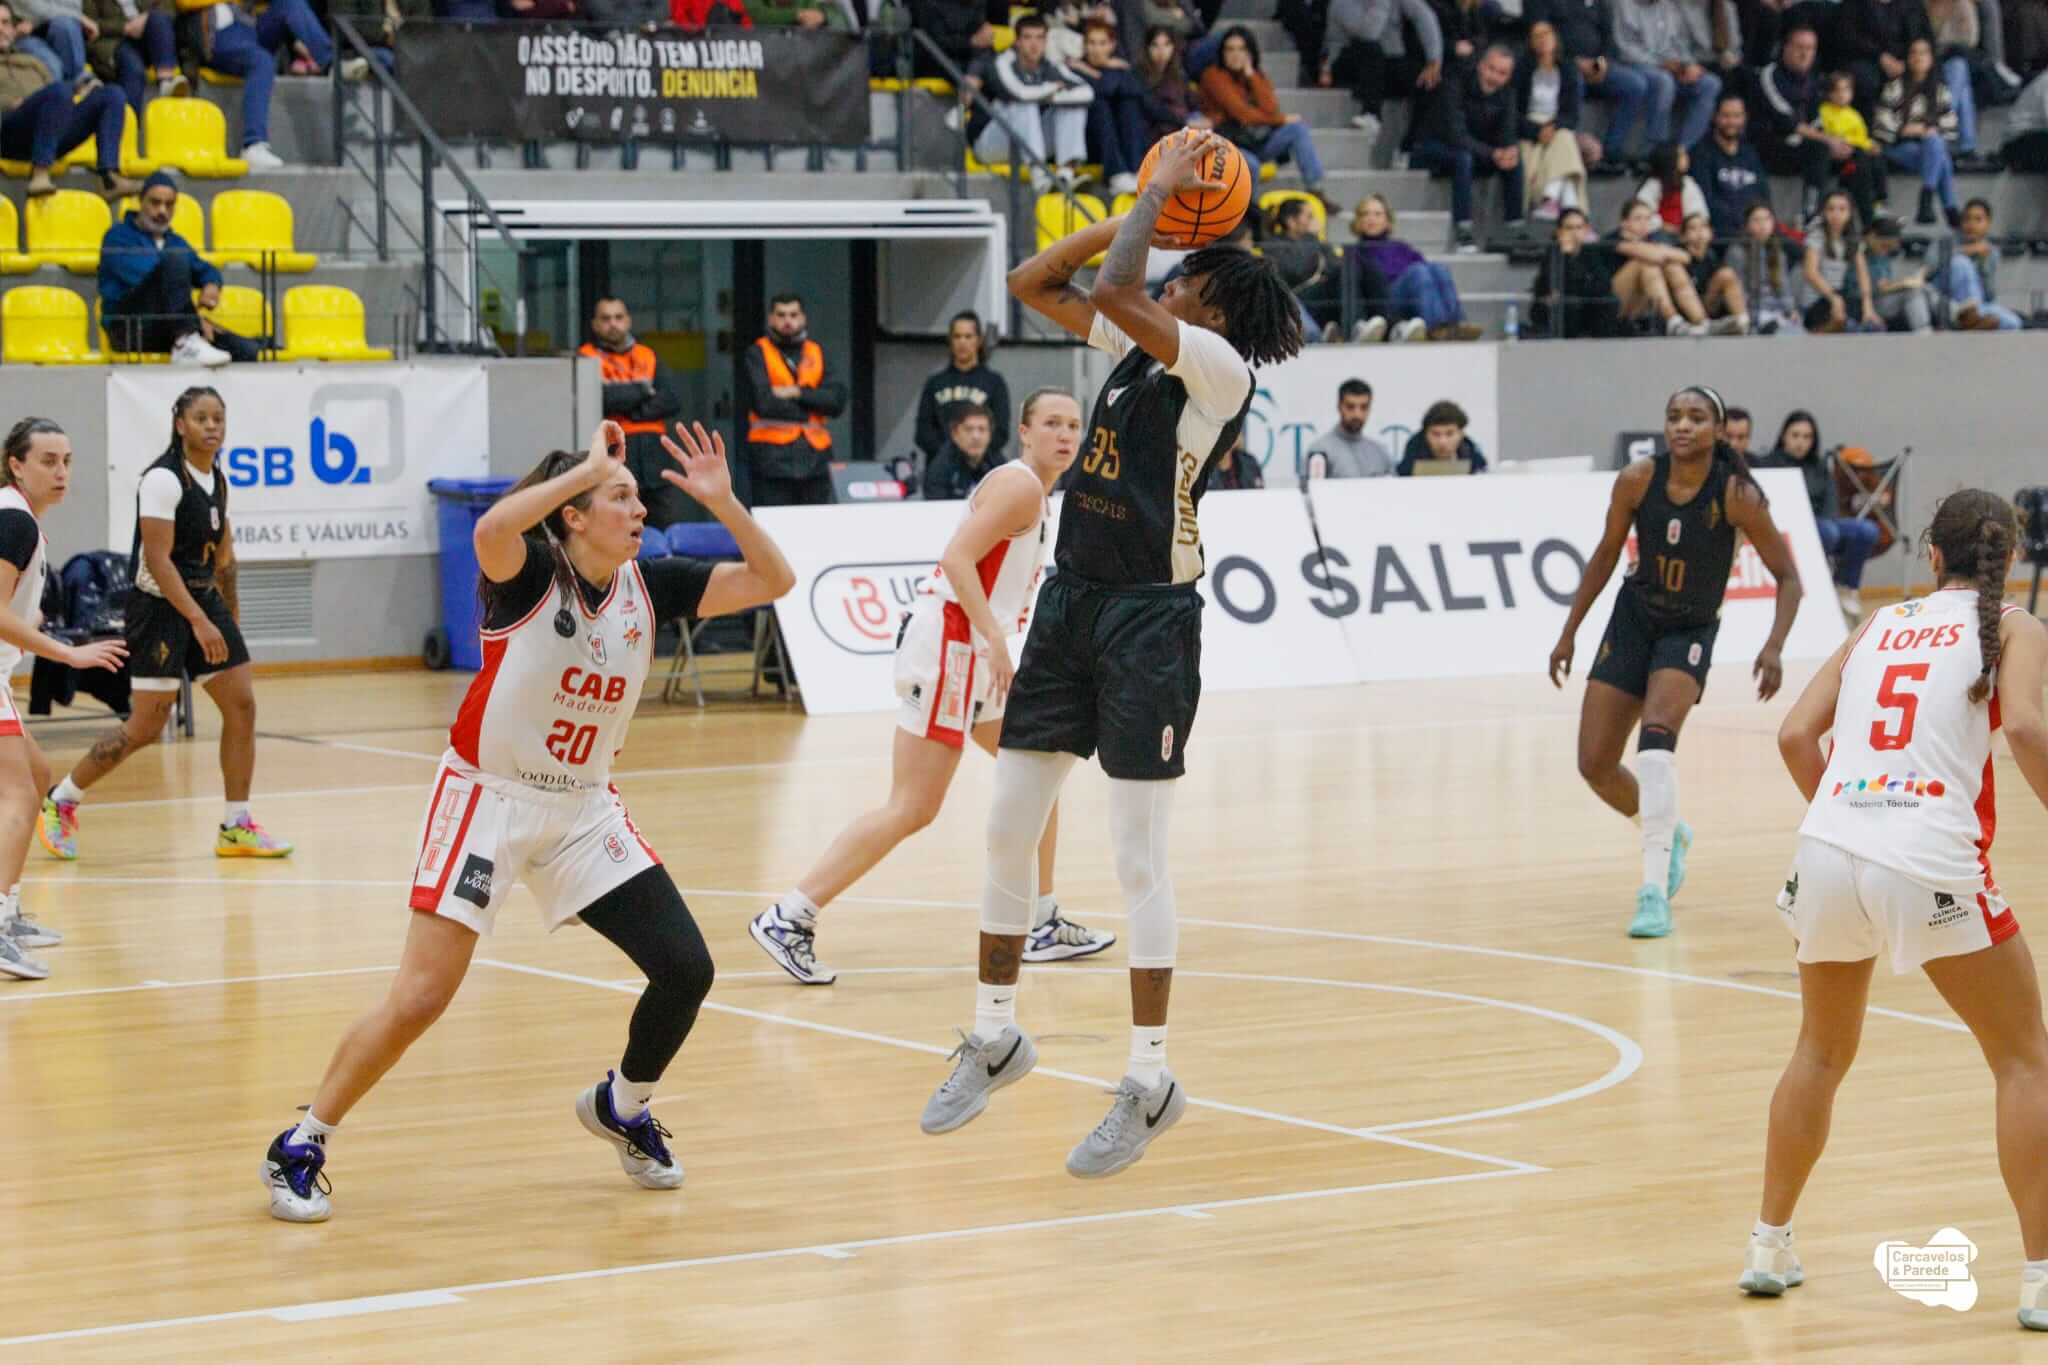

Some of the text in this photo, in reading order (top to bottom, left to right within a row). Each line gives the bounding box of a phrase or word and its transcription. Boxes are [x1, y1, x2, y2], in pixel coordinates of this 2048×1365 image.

[518, 35, 529, 66] O
[530, 31, 615, 66] ASSÉDIO
[654, 41, 698, 68] TEM
[701, 40, 764, 70] LUGAR
[525, 66, 550, 96] NO
[227, 447, 294, 488] SB
[1083, 426, 1120, 480] 35
[232, 519, 409, 544] MBAS E VÁLVULAS
[1211, 537, 1588, 624] O SALTO
[1656, 555, 1685, 592] 10
[1876, 623, 1965, 652] LOPES
[552, 690, 617, 715] Madeira
[560, 666, 627, 704] CAB
[1869, 663, 1930, 751] 5
[545, 718, 599, 766] 20
